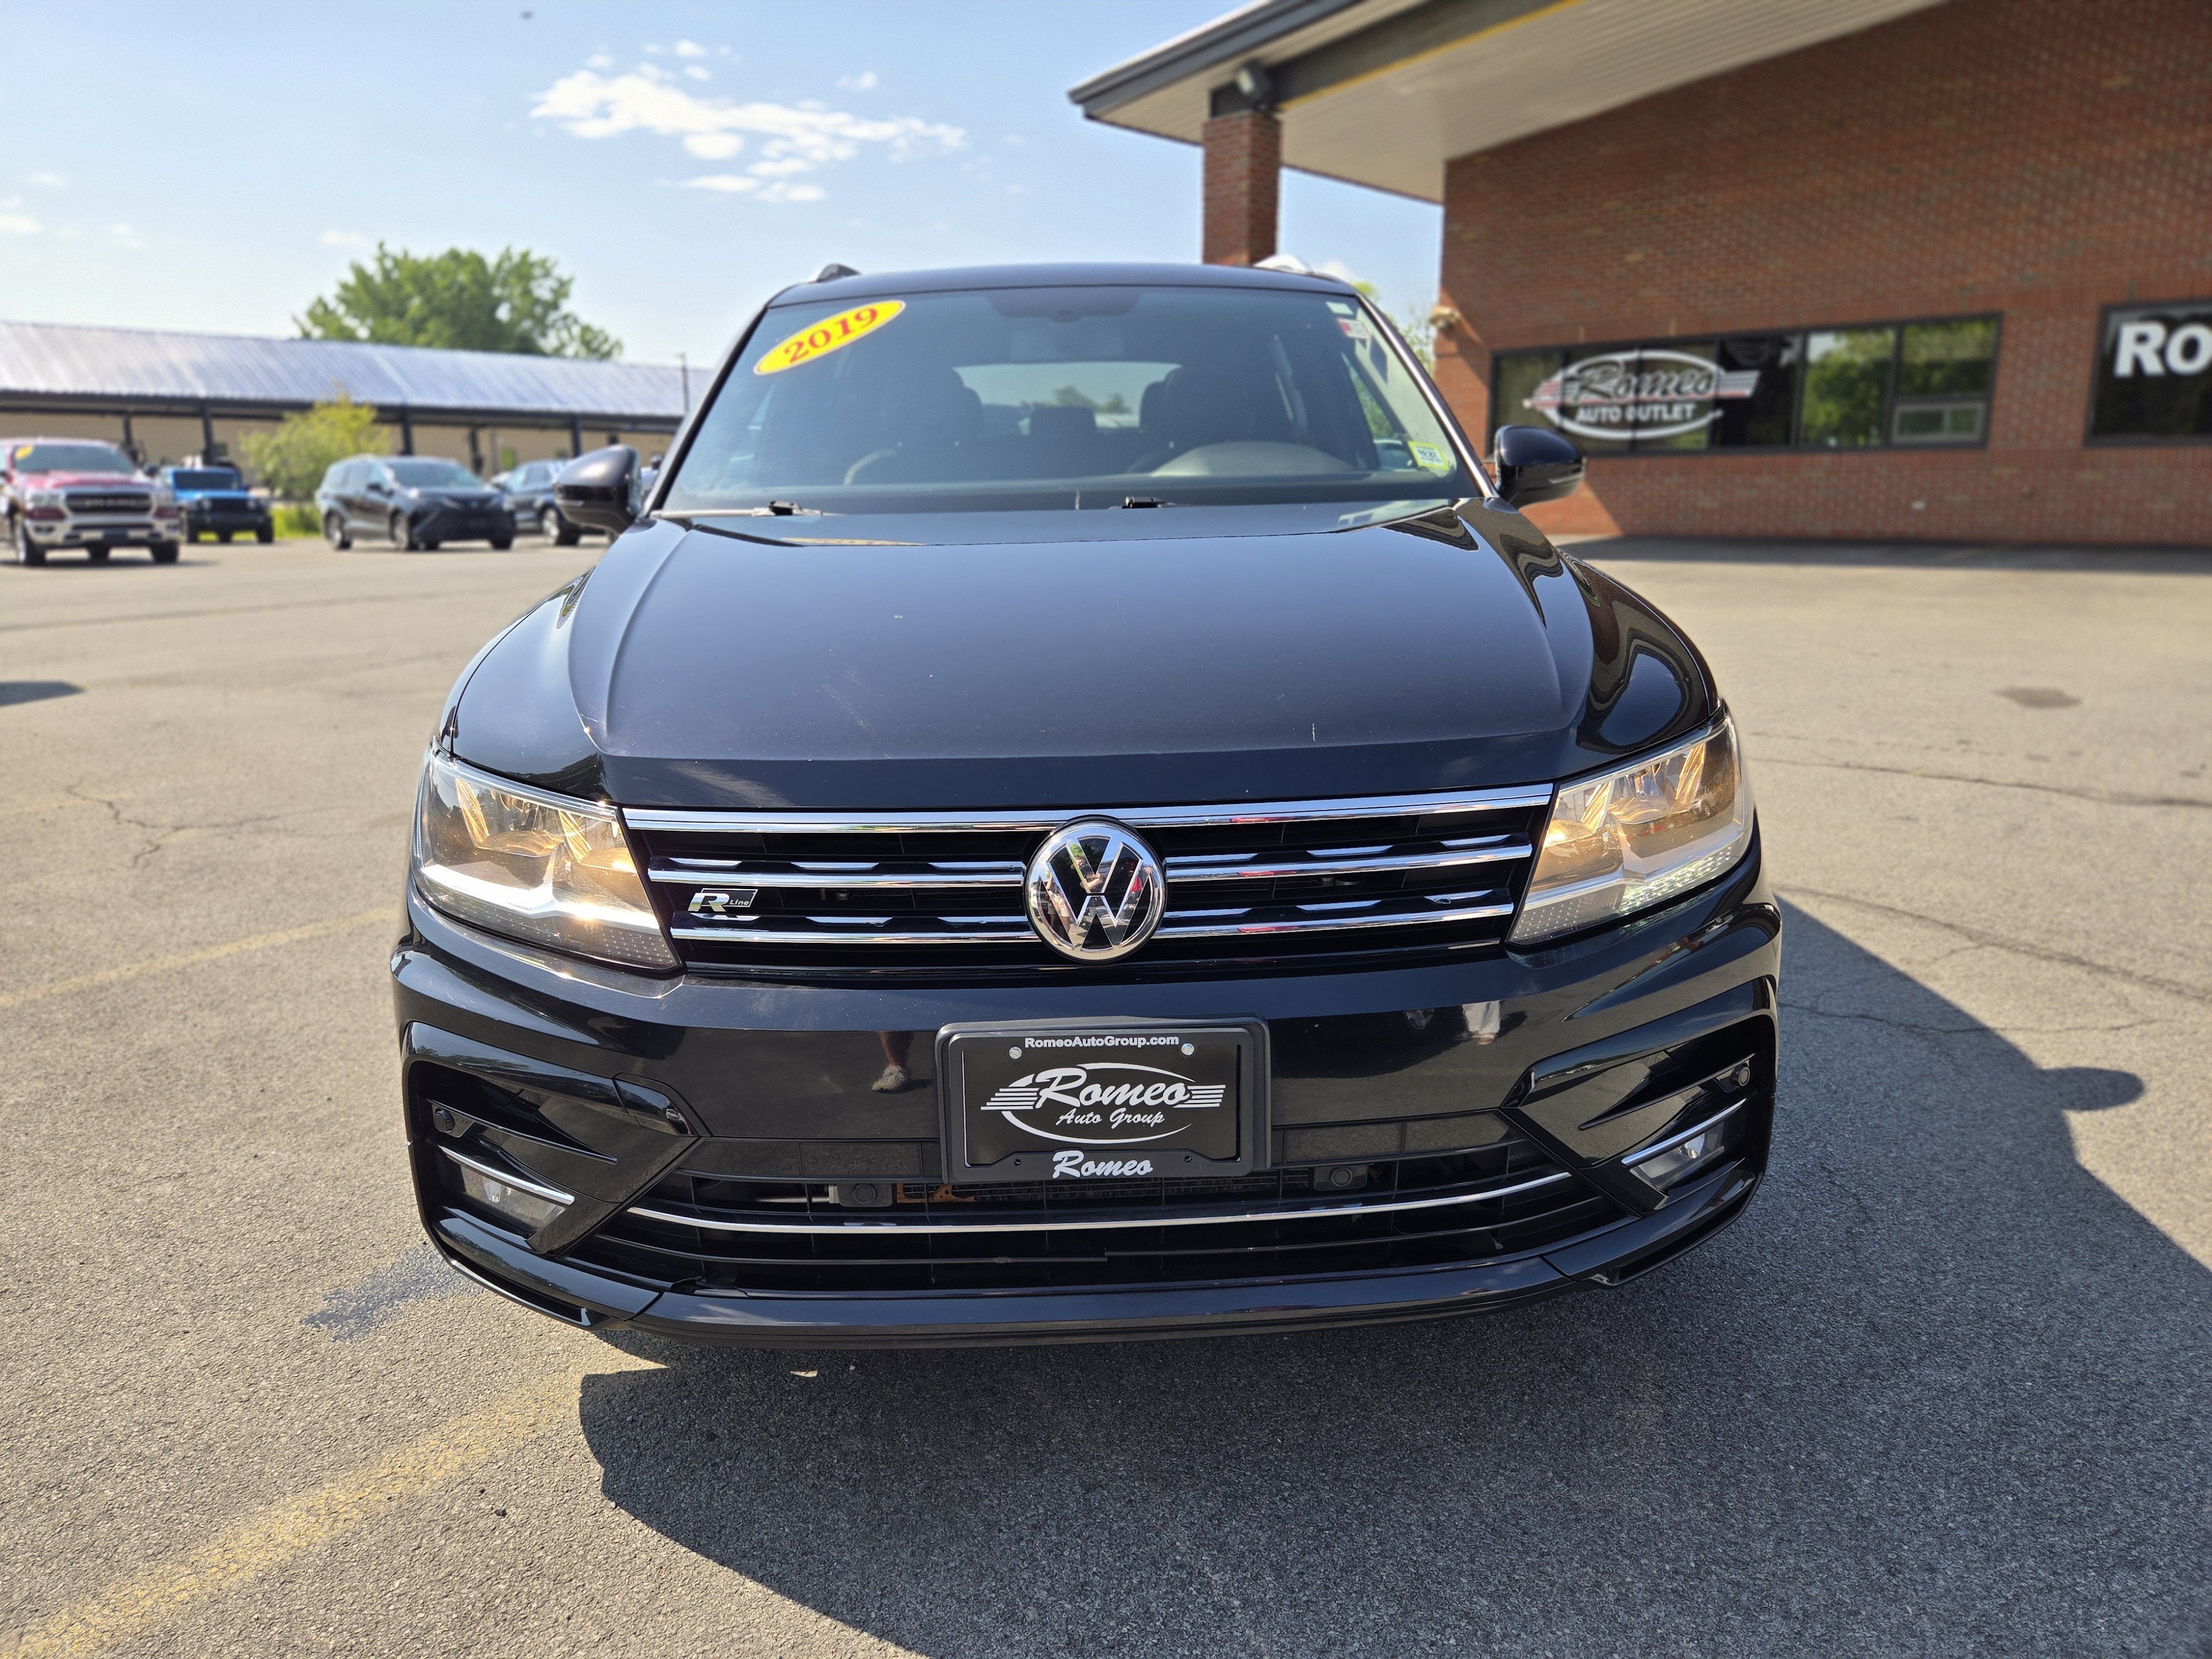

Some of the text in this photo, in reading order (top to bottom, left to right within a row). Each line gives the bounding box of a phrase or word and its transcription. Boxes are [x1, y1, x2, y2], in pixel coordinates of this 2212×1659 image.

[784, 307, 878, 363] 2019
[1572, 361, 1713, 399] Romeo
[1577, 405, 1621, 422] AUTO
[1025, 1036, 1179, 1048] RomeoAutoGroup.com
[1036, 1067, 1190, 1108] Romeo
[1056, 1108, 1165, 1129] Auto Group
[1052, 1150, 1153, 1178] Romeo
